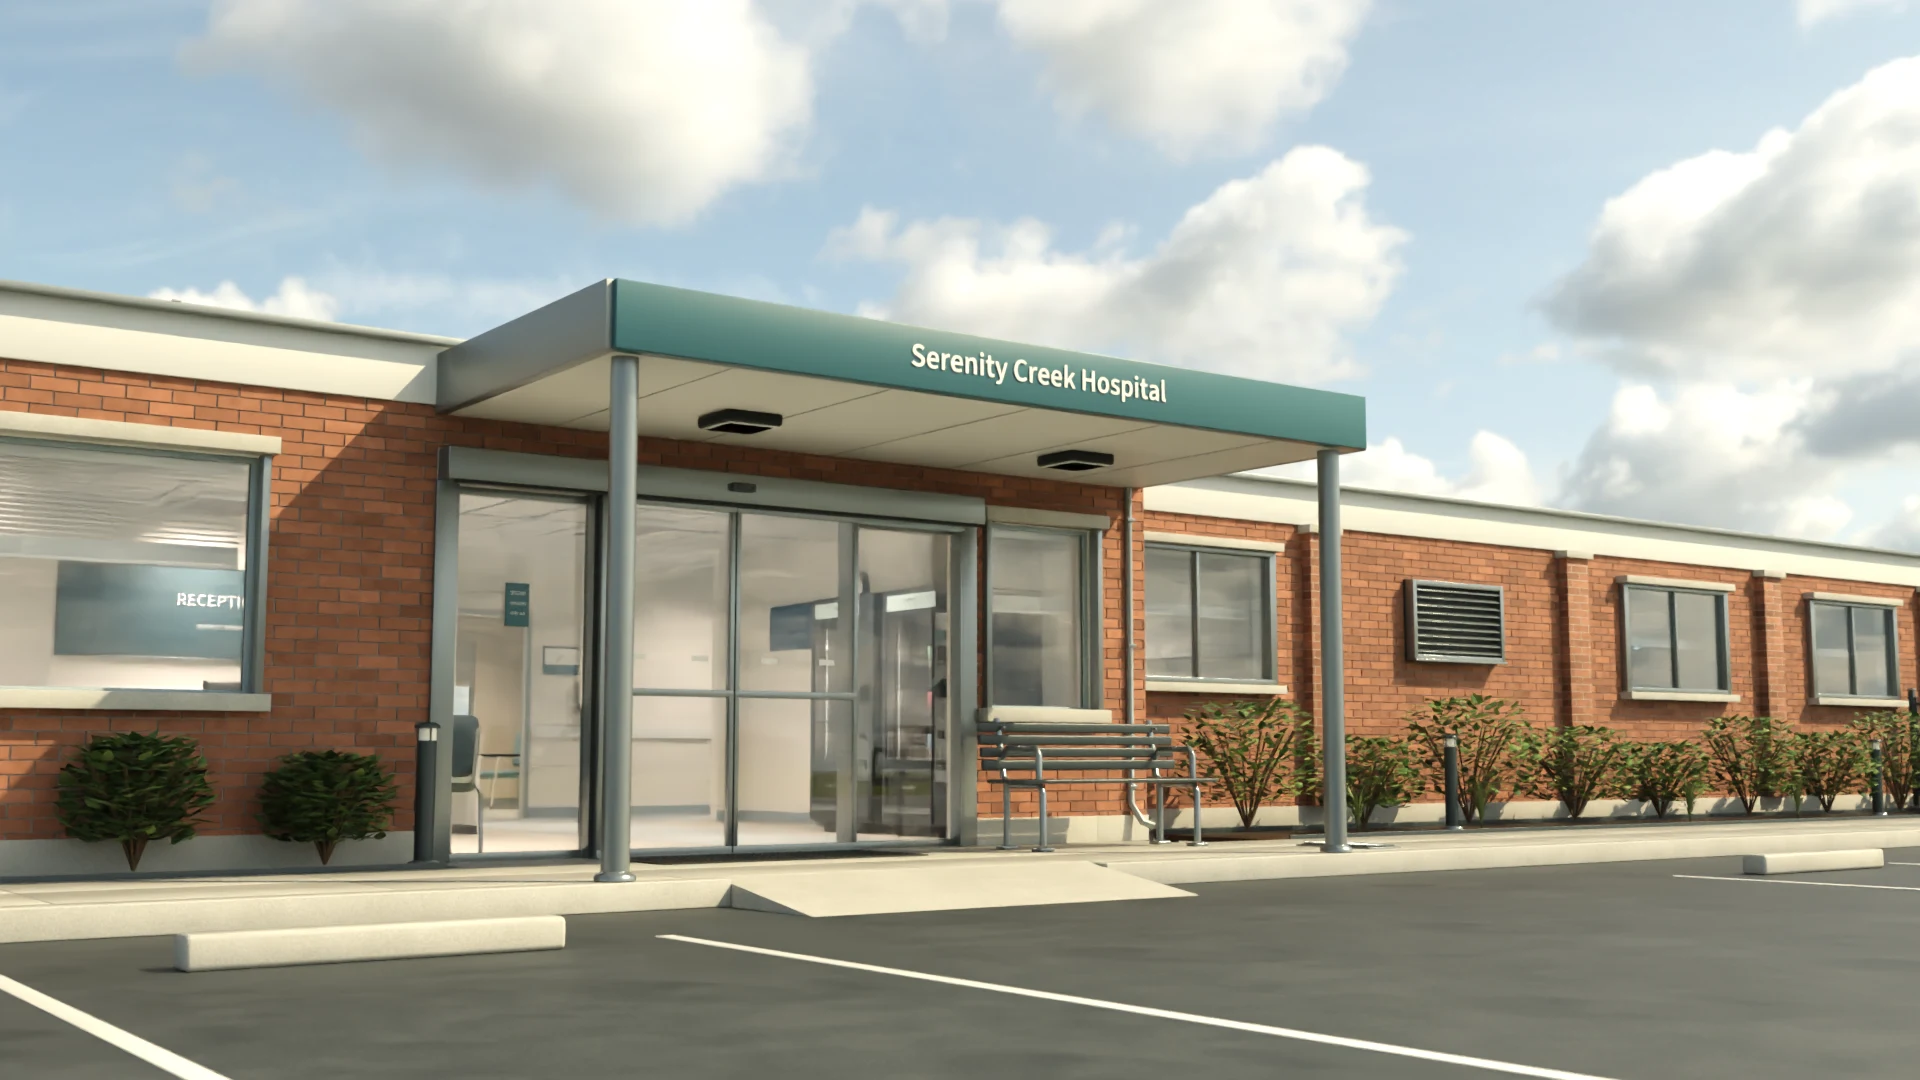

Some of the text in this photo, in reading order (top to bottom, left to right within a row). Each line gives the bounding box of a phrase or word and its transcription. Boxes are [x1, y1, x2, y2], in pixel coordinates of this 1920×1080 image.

[911, 343, 1167, 403] Serenity Creek Hospital
[176, 592, 244, 610] RECEPTI
